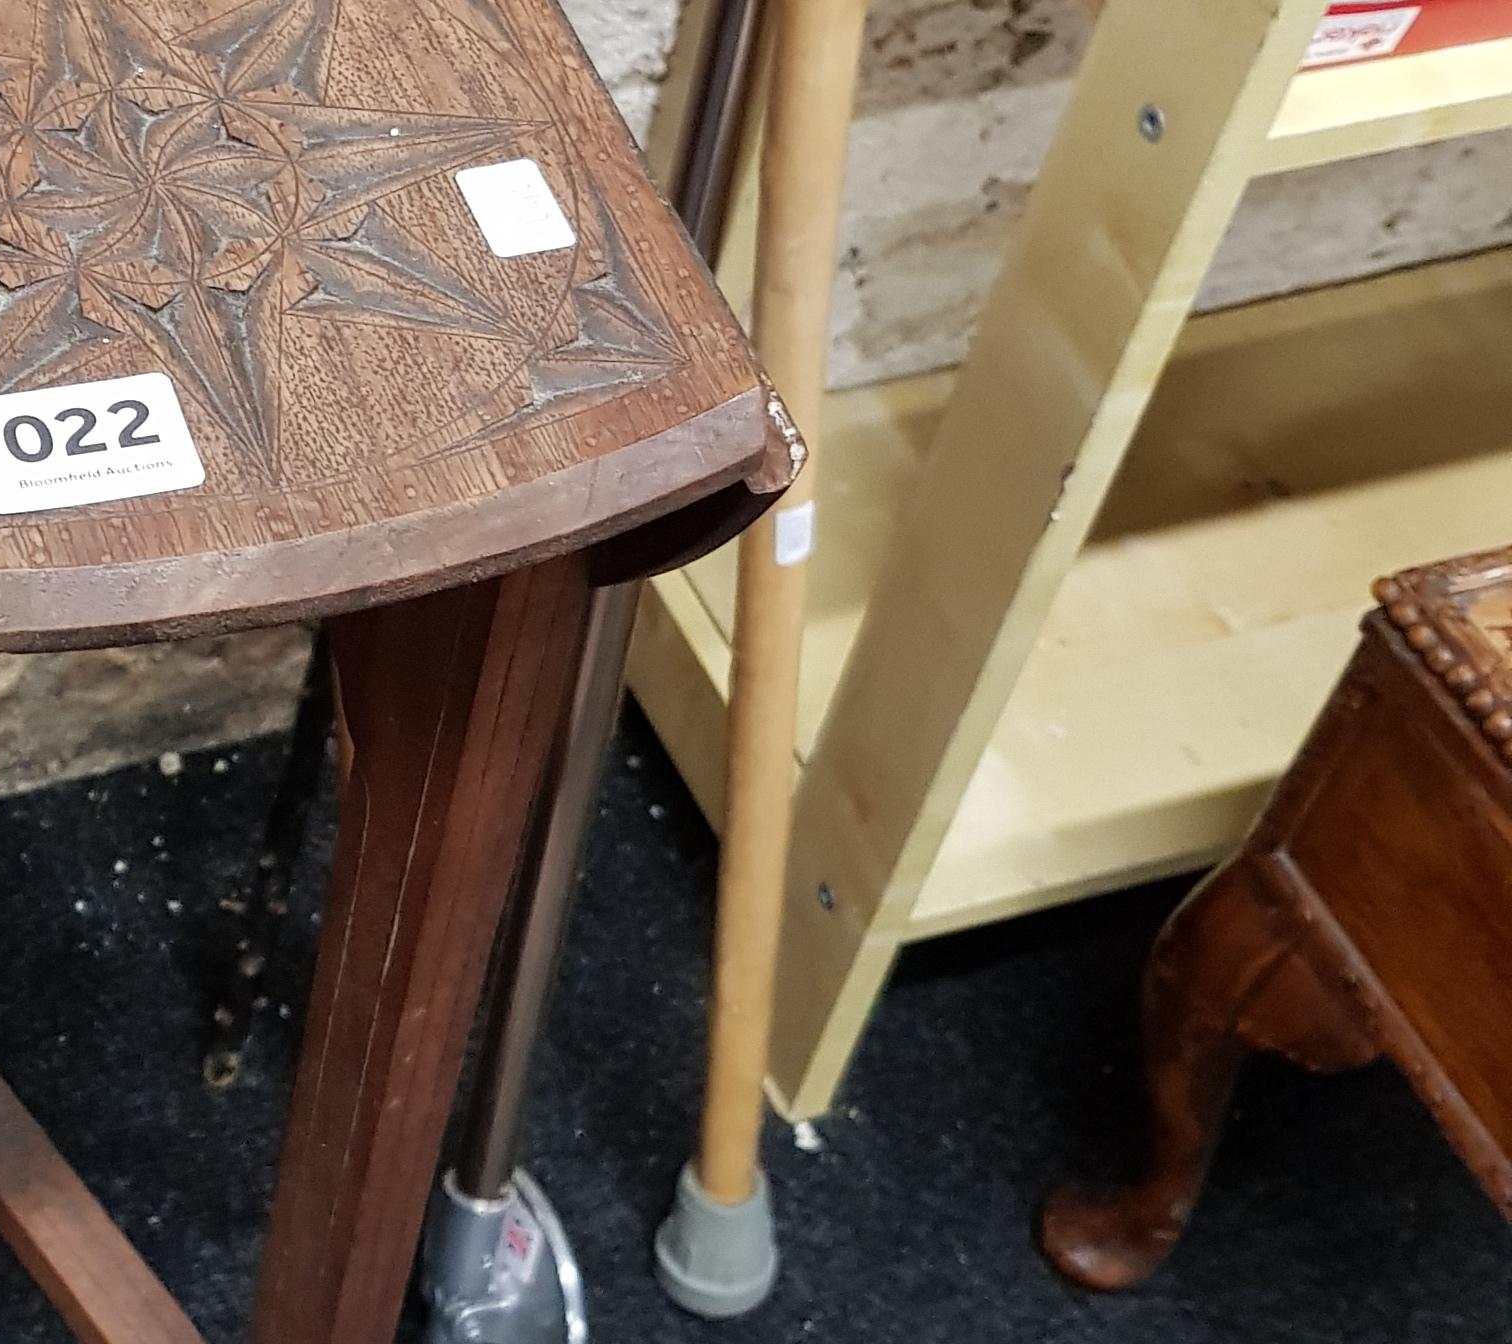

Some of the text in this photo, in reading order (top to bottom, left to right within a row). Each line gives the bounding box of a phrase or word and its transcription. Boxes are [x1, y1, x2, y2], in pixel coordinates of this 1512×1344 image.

[3, 399, 161, 463] 022
[18, 459, 174, 489] Bloomfield Auctions
